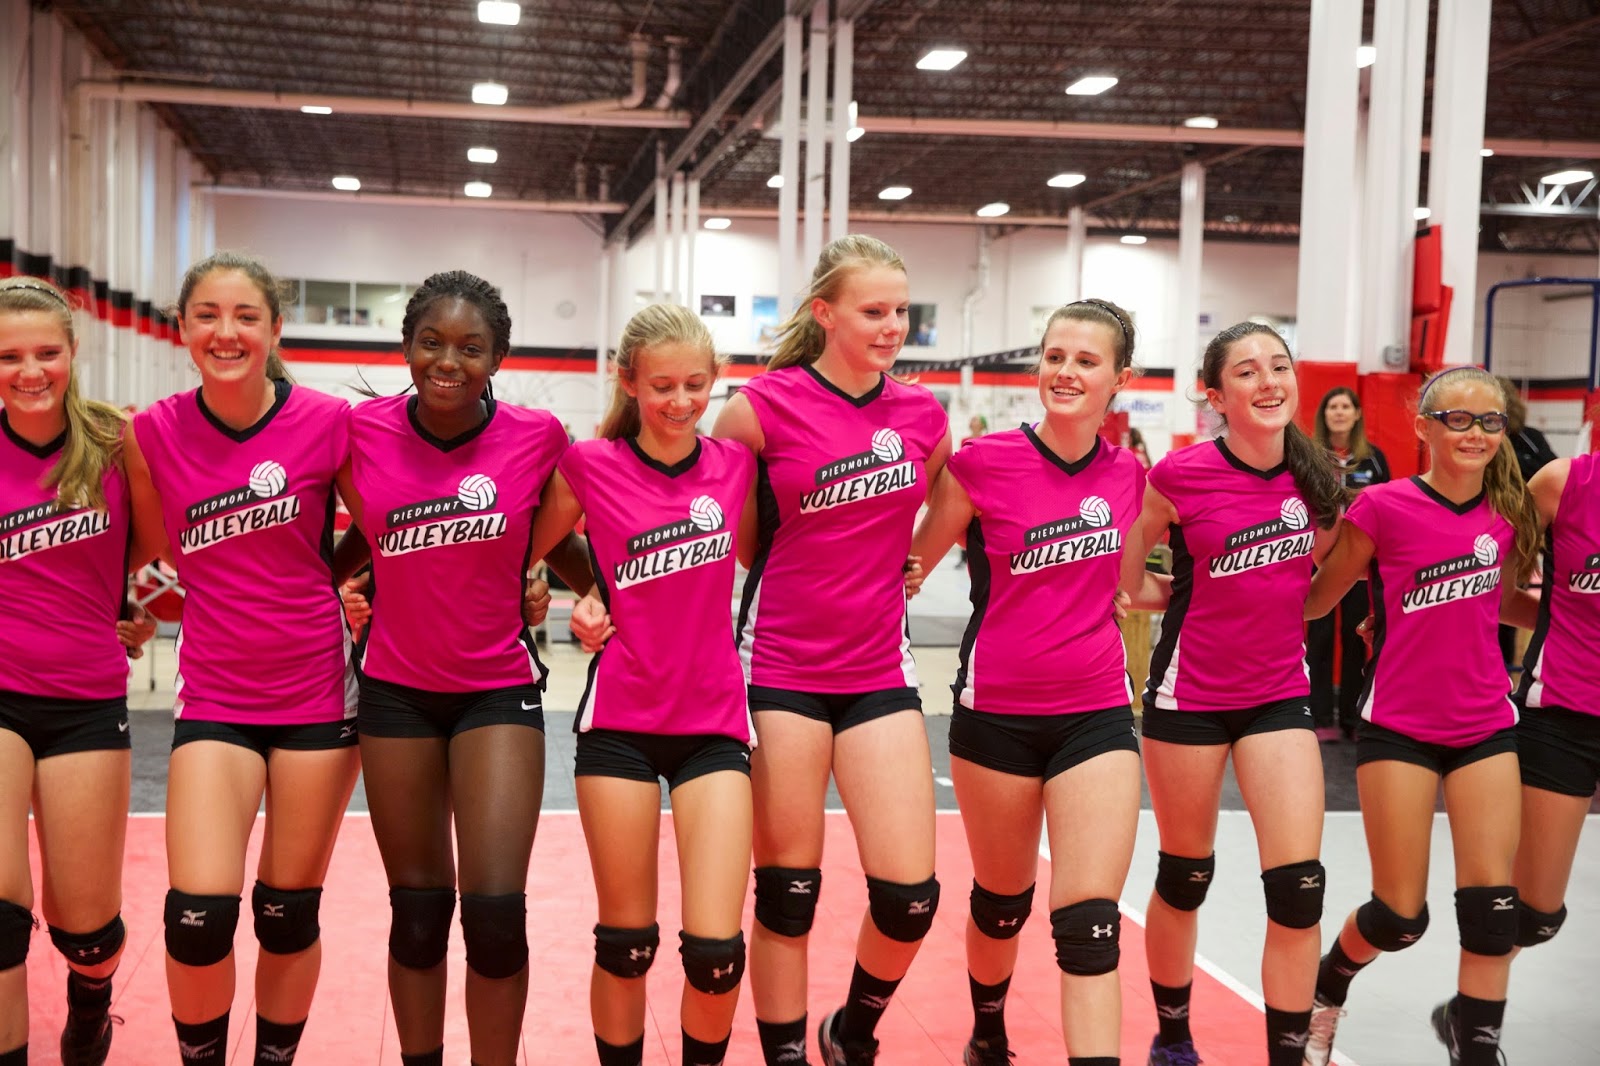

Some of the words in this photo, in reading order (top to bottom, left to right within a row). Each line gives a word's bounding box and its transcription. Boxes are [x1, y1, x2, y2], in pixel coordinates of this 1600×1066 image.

[822, 455, 876, 480] PIEDMONT
[800, 463, 917, 510] VOLLEYBALL
[191, 489, 253, 519] PIEDMONT
[393, 501, 460, 523] PIEDMONT
[179, 496, 301, 549] VOLLEYBALL
[375, 514, 507, 552] VOLLEYBALL
[633, 523, 694, 550] PIEDMONT
[1030, 520, 1084, 541] PIEDMONT
[1231, 522, 1284, 546] PIEDMONT
[614, 532, 732, 583] VOLLEYBALL
[1010, 530, 1121, 570] VOLLEYBALL
[1210, 533, 1315, 573] VOLLEYBALL
[1421, 557, 1477, 580] PIEDMONT
[1402, 567, 1501, 608] VOLLEYBALL
